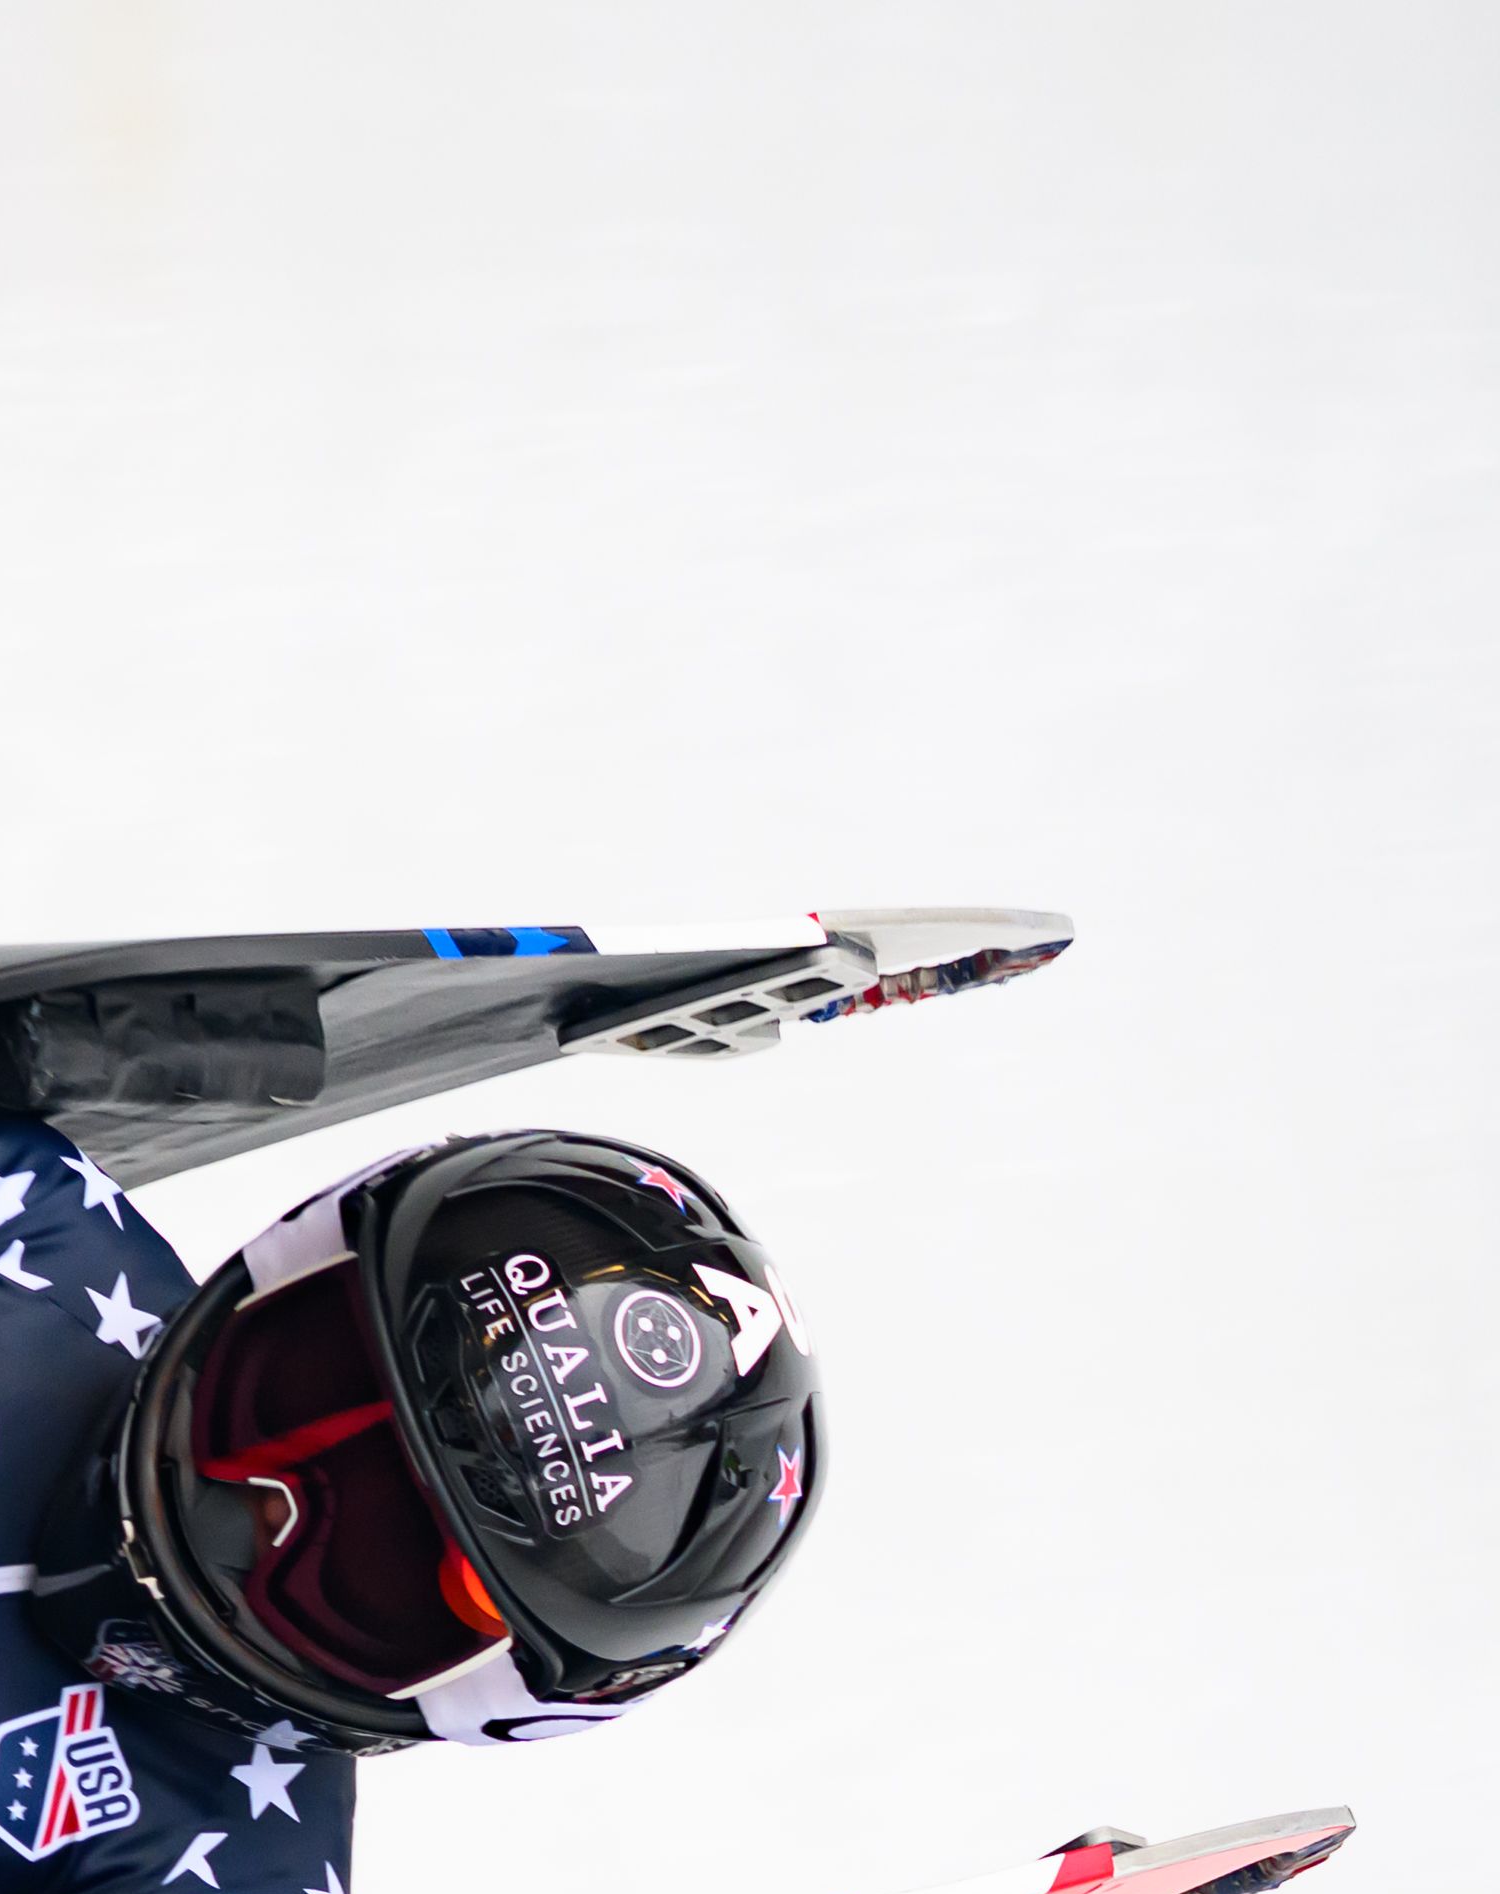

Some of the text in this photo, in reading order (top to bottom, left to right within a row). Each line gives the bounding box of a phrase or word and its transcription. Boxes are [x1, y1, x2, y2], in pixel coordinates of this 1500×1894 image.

[460, 1271, 582, 1527] LIFE SCIENCES
[503, 1253, 633, 1513] QUALIA
[64, 1734, 133, 1829] USA
